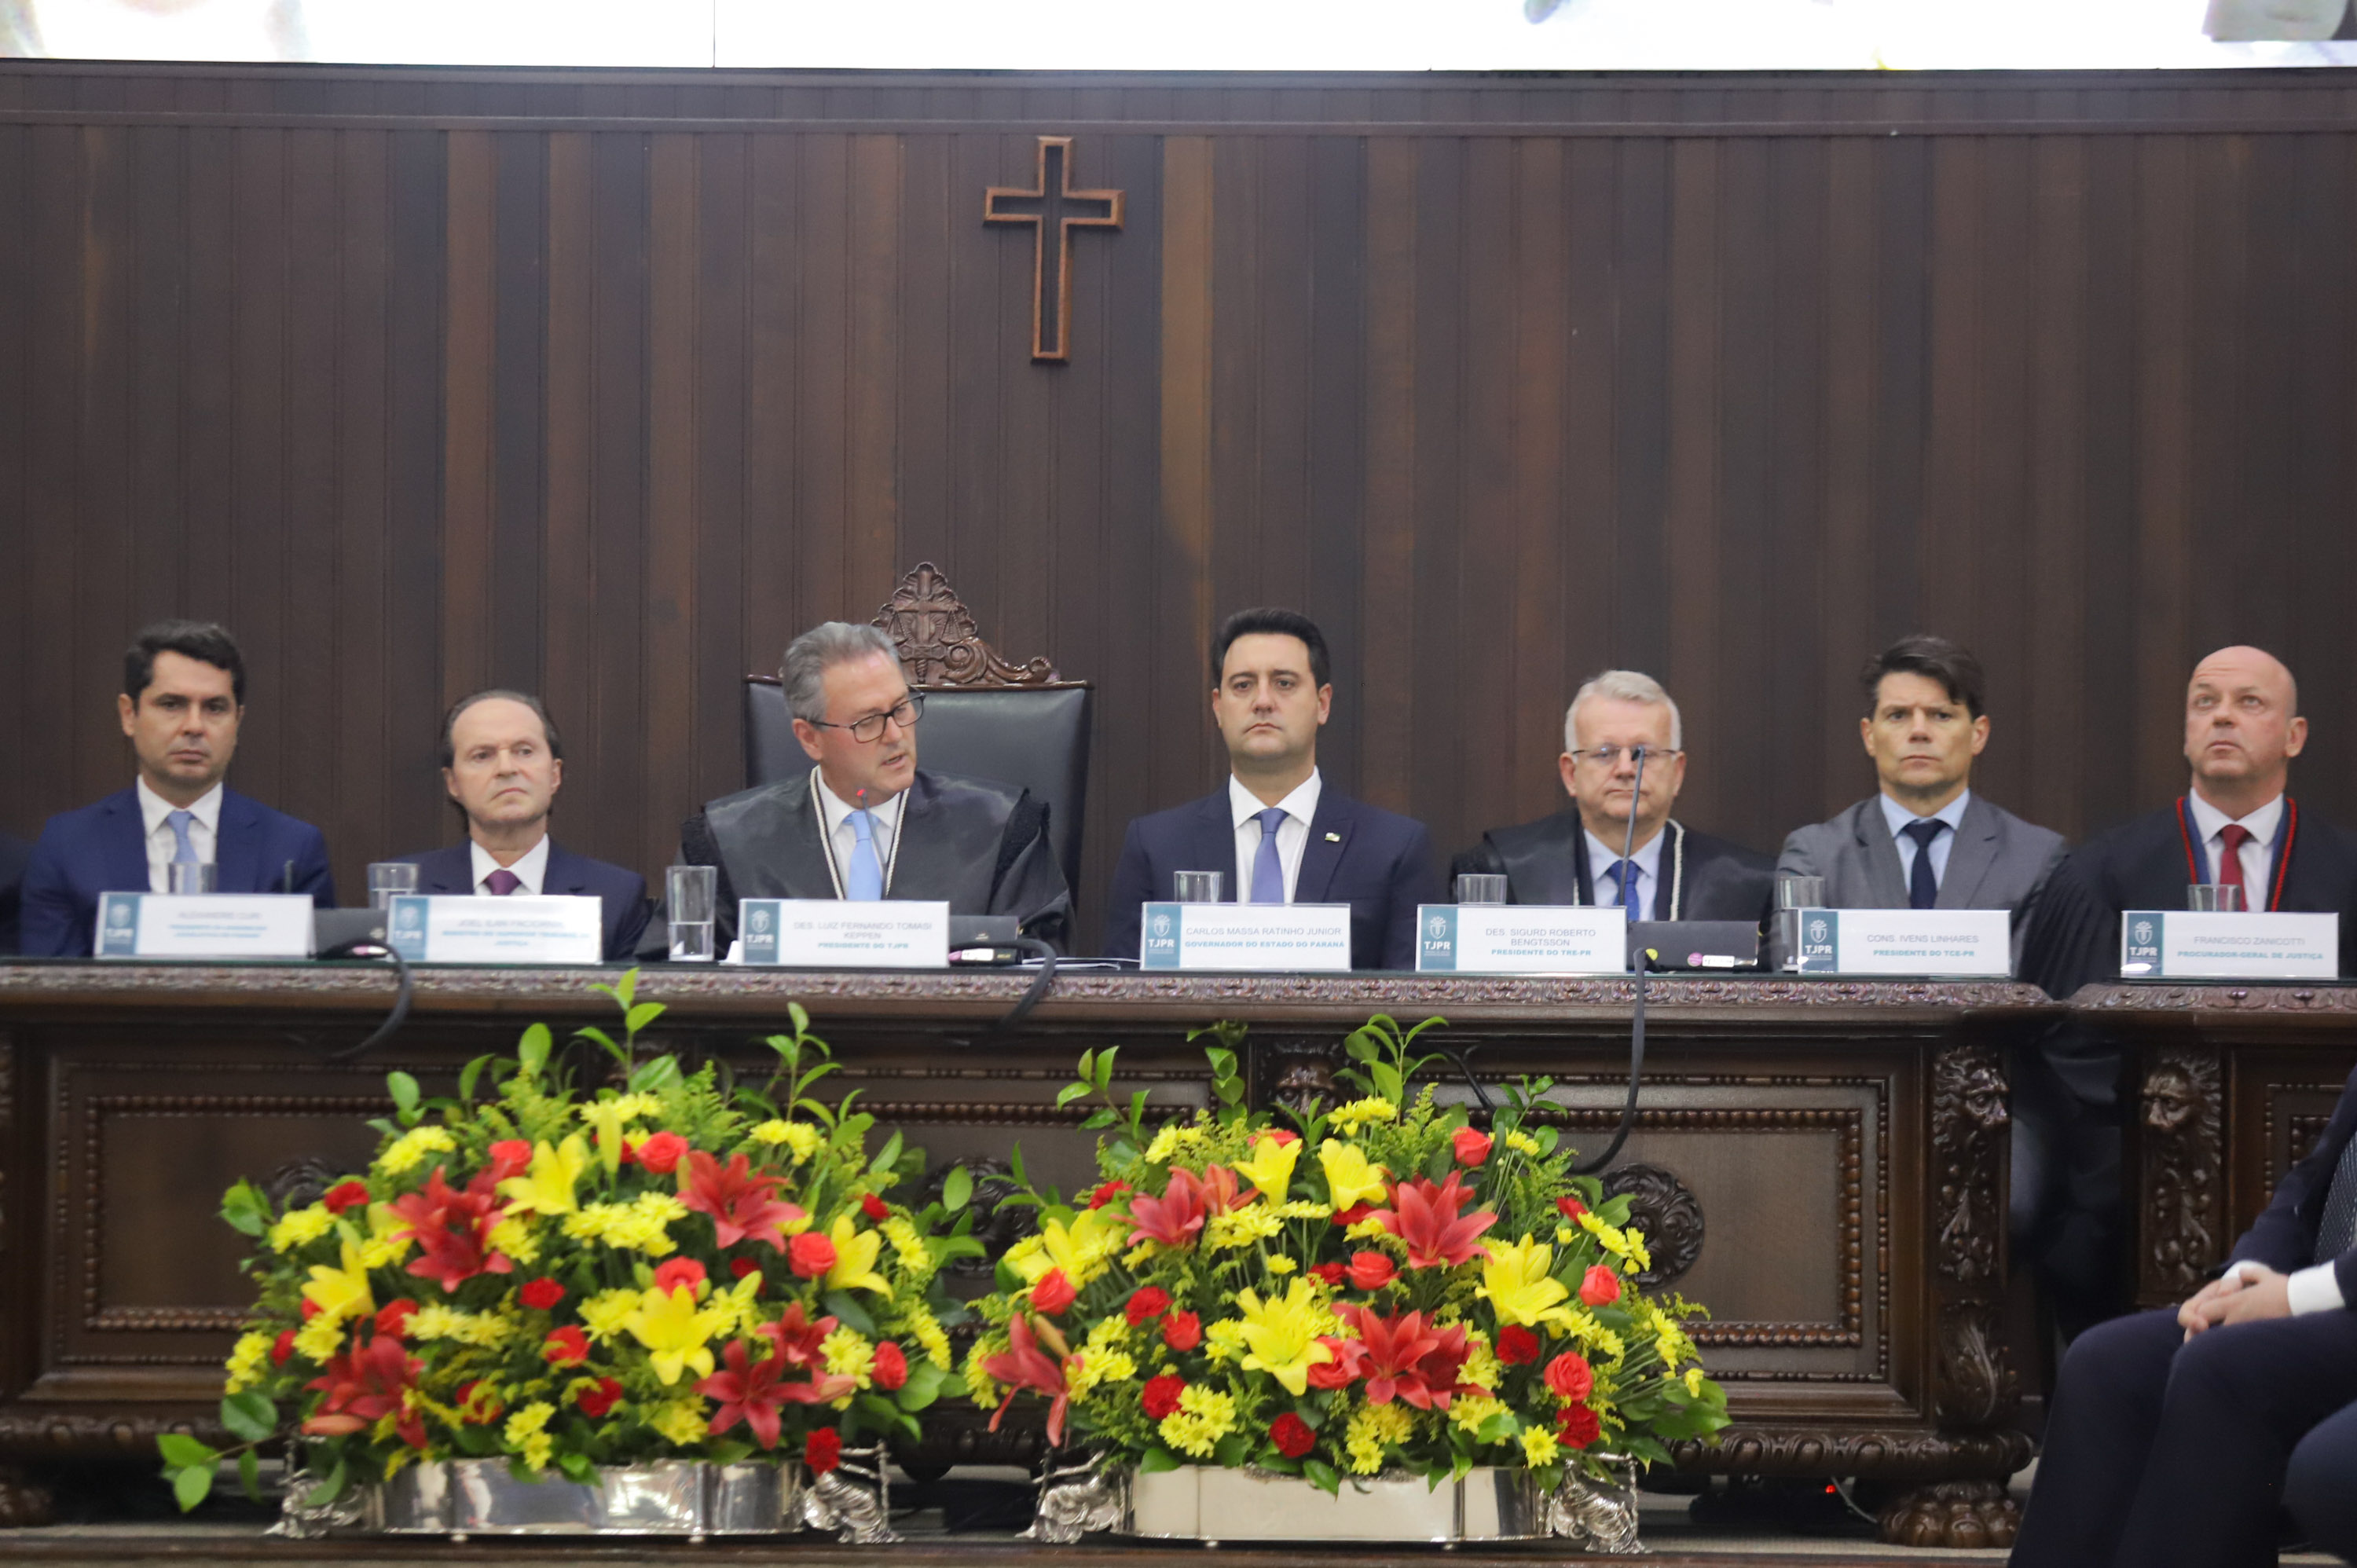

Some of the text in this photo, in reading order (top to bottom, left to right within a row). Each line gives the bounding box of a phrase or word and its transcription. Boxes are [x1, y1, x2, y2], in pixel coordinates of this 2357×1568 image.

[394, 930, 422, 940] TJPR
[1186, 927, 1341, 936] CARLOS MASSA RATINHO JUNIOR
[746, 934, 773, 943] TJPR
[1148, 939, 1174, 947] TJPR
[1512, 938, 1570, 947] BENGTSSON
[1901, 935, 1928, 943] IVENS
[1931, 935, 1978, 943] LINHARES
[2194, 936, 2304, 946] FRANCISCO ZANICOTTI
[1424, 941, 1450, 950] TJPR
[1805, 945, 1832, 954] TJPR
[2129, 947, 2157, 956] TJPR
[2178, 951, 2267, 959] PROCURADOR-GERAL
